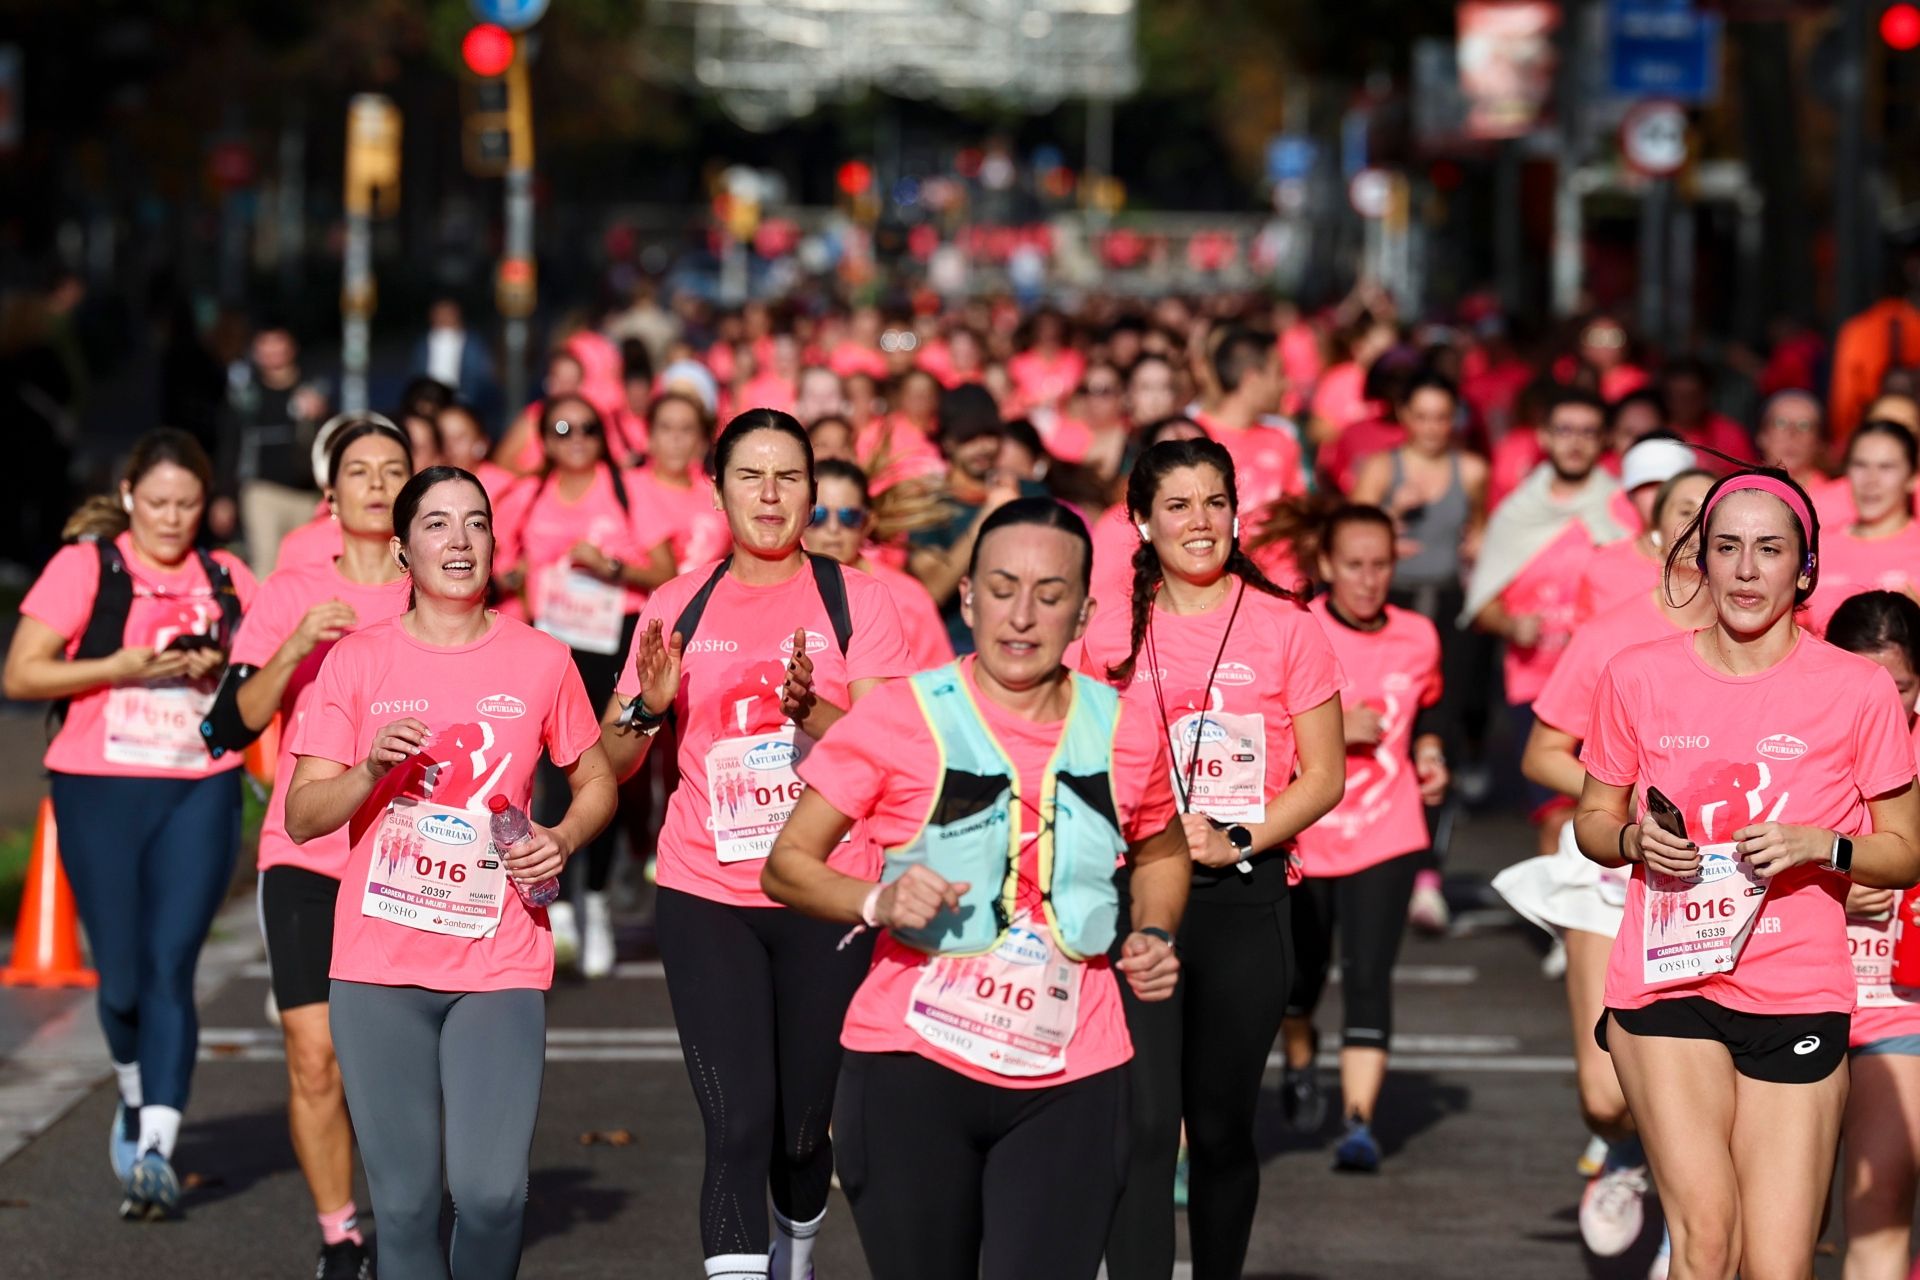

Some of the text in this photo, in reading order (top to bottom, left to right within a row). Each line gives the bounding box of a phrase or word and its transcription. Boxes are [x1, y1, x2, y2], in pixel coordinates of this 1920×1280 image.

[685, 639, 738, 653] OYSHO
[370, 698, 429, 715] OYSHO
[1659, 735, 1710, 749] OYSHO
[1184, 757, 1223, 777] 16
[755, 781, 803, 806] 016
[388, 816, 414, 829] SUMA
[421, 820, 473, 841] ASTURIANA
[415, 855, 468, 884] 016
[380, 886, 406, 901] CARRERA
[406, 893, 417, 903] DE
[416, 895, 425, 905] LA
[451, 903, 487, 916] BARCELONA
[420, 885, 452, 900] 20397
[469, 892, 496, 901] HUAWEI
[378, 901, 418, 919] OYSHO
[1685, 897, 1736, 922] 016
[1695, 926, 1726, 940] 16339
[1657, 945, 1684, 957] CARRERA
[1684, 944, 1694, 953] DE
[1693, 942, 1702, 951] LA
[1702, 939, 1724, 950] MUJER
[976, 976, 1036, 1011] 016
